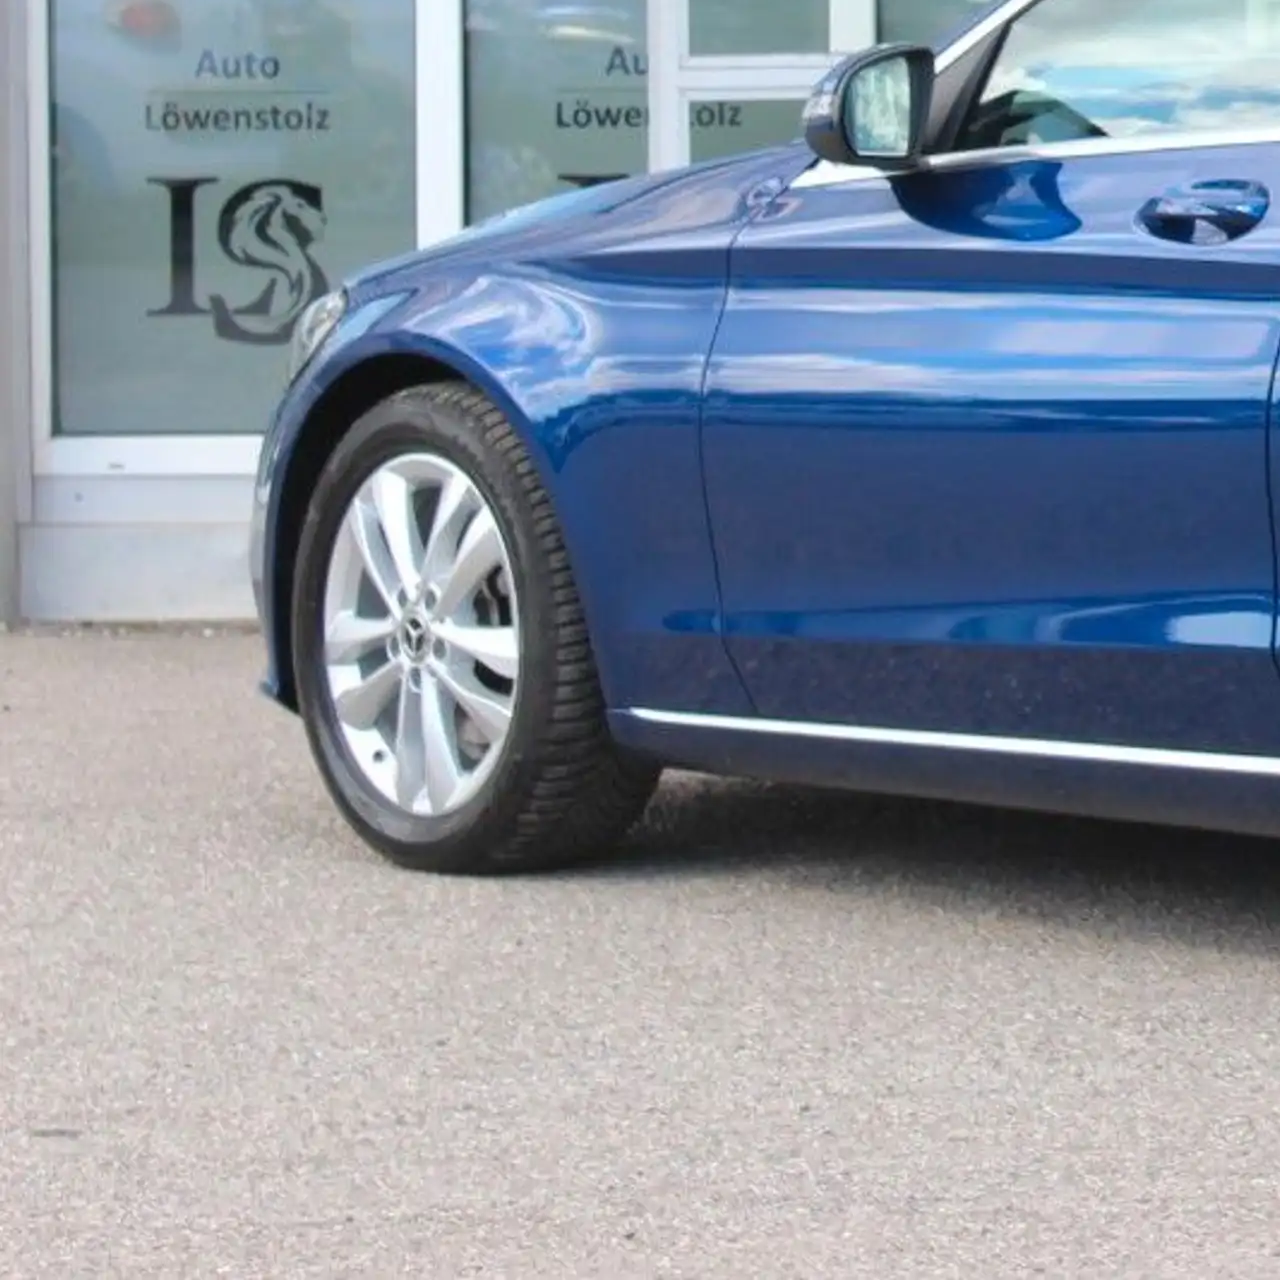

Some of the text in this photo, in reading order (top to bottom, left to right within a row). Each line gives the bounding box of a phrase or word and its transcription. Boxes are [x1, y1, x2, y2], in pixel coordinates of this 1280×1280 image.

[195, 49, 281, 79] Auto
[605, 45, 649, 76] Au
[145, 102, 330, 131] Löwenstolz
